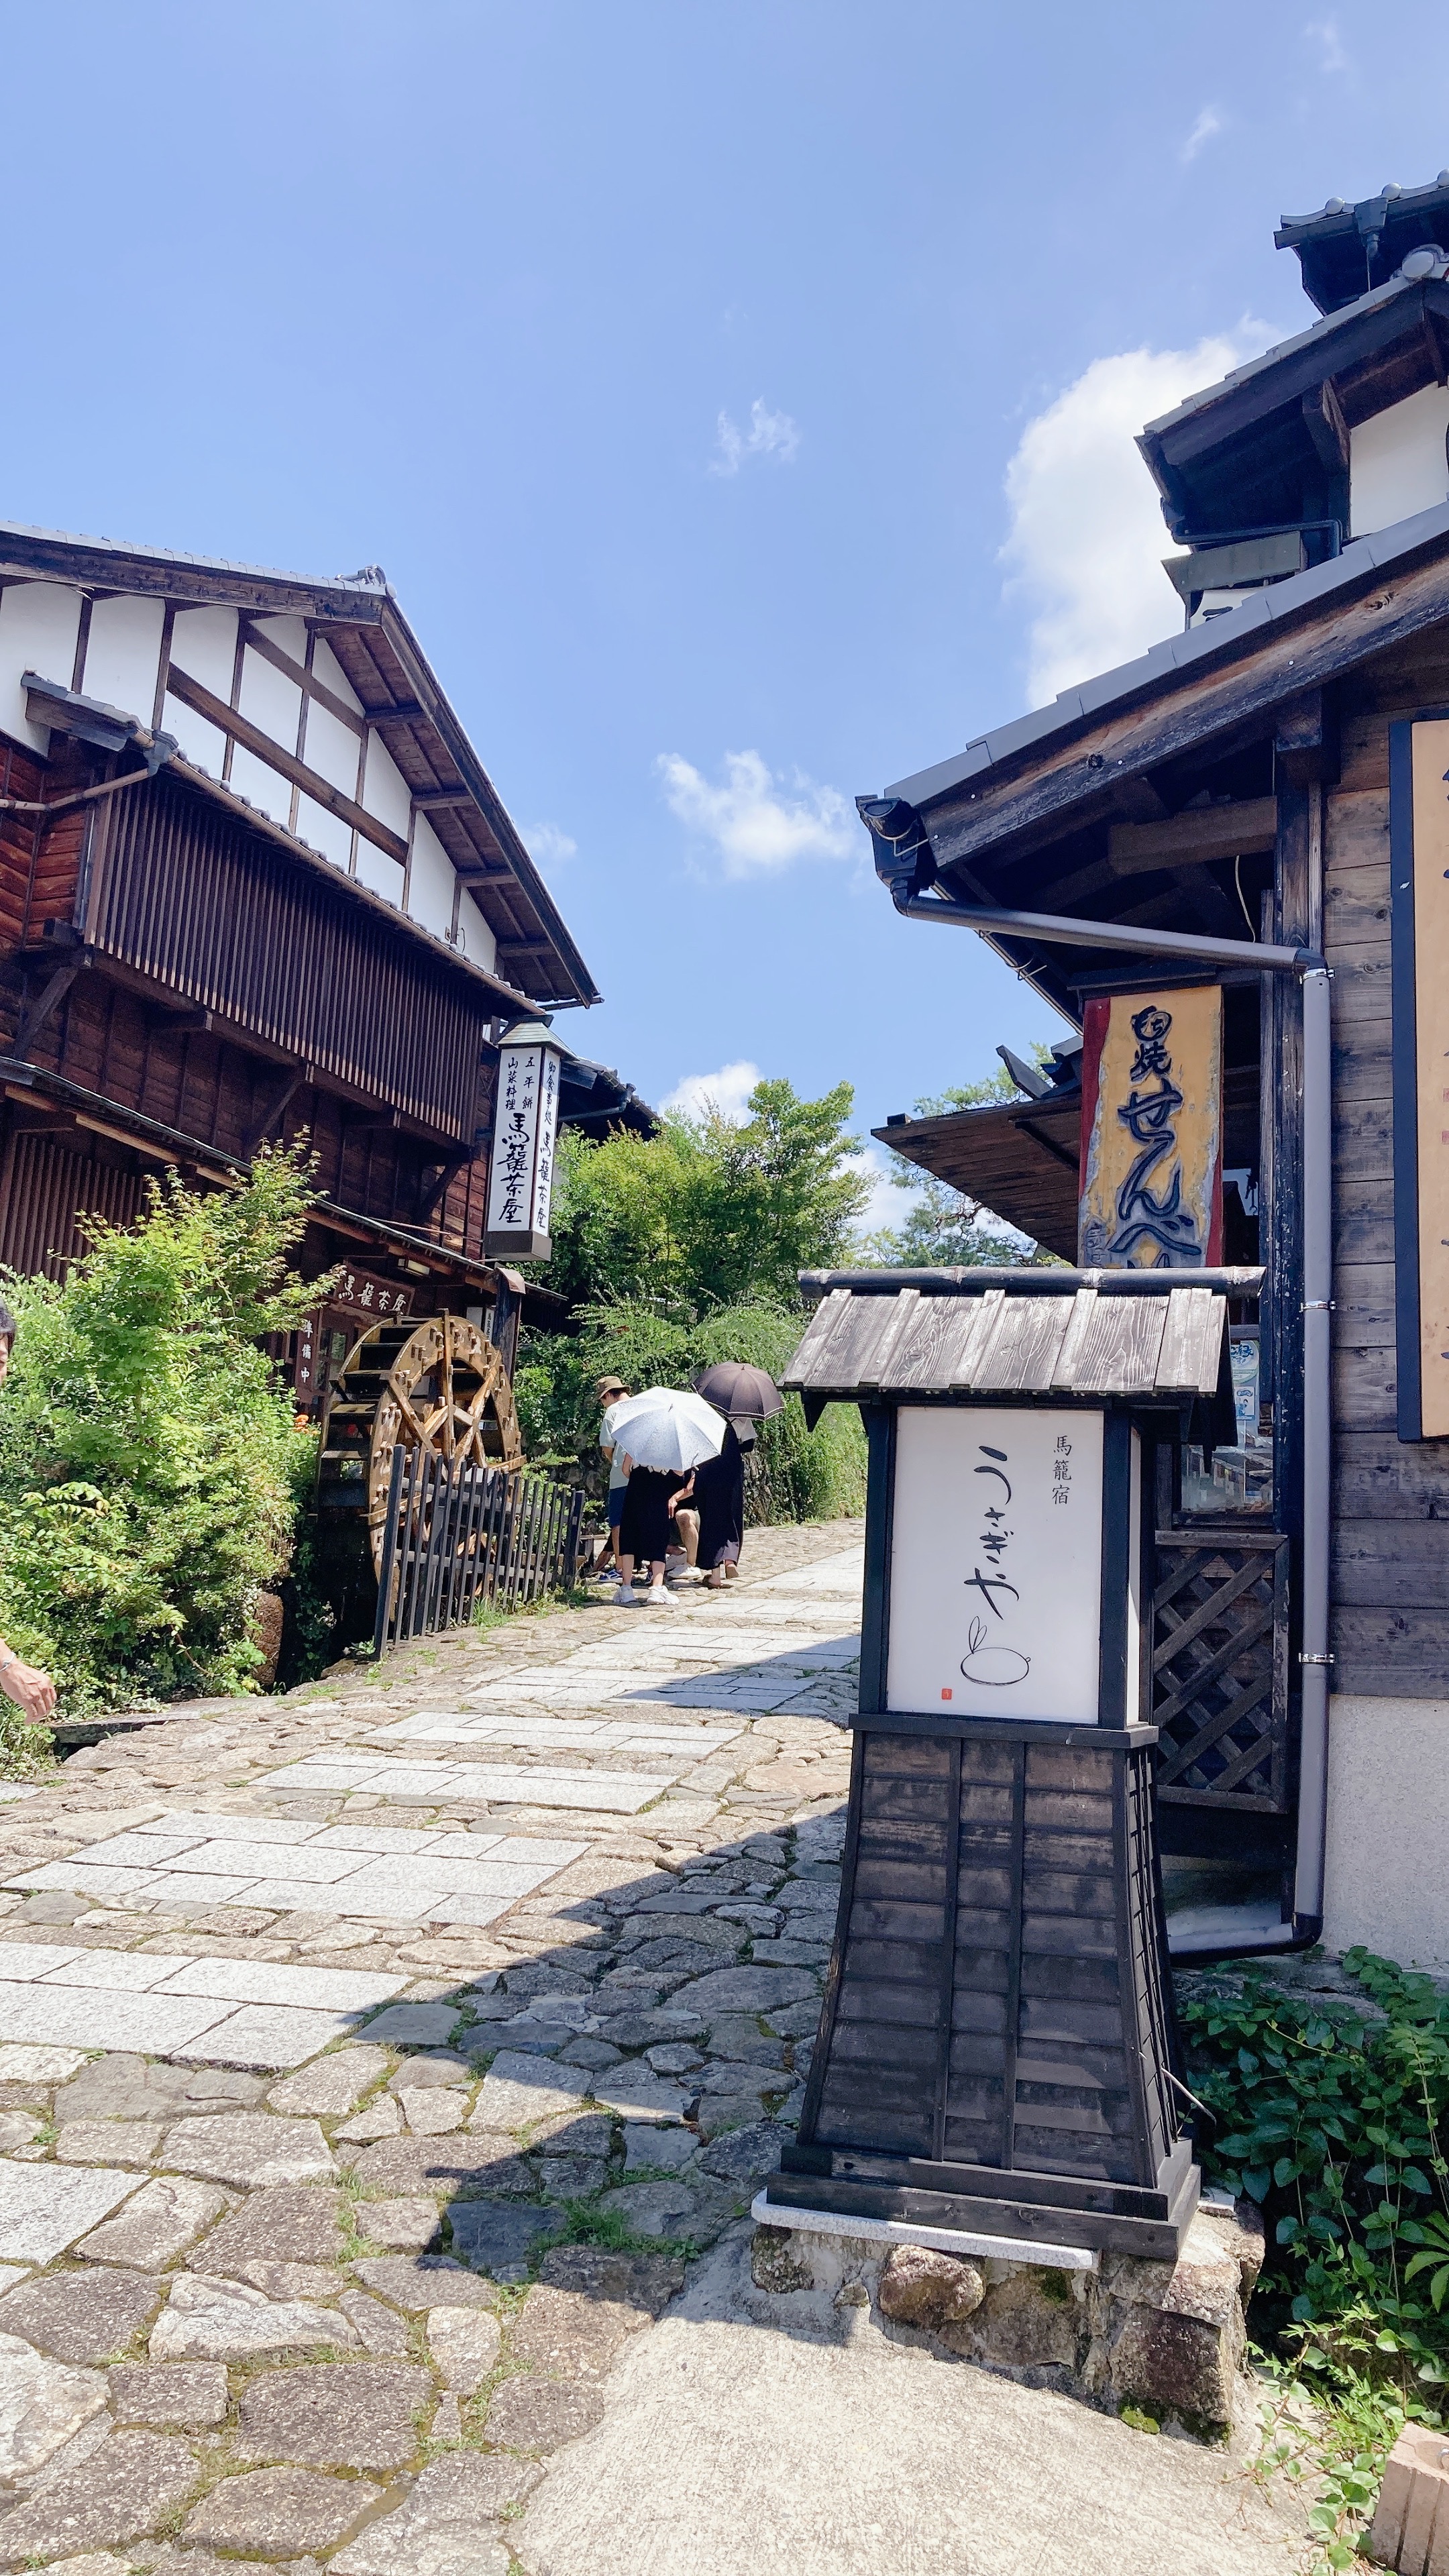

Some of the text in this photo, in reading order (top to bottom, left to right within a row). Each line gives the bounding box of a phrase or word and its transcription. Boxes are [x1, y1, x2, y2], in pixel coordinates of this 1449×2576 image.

[505, 1057, 519, 1111] 山菜料理
[497, 1112, 531, 1223] 馬籠茶屋
[537, 1132, 551, 1229] 馬籠茶屋
[338, 1275, 406, 1315] 馬籠茶屋
[301, 1320, 313, 1383] 準備中
[1052, 1436, 1072, 1505] 馬籠宿
[964, 1446, 1020, 1621] うさぎや
